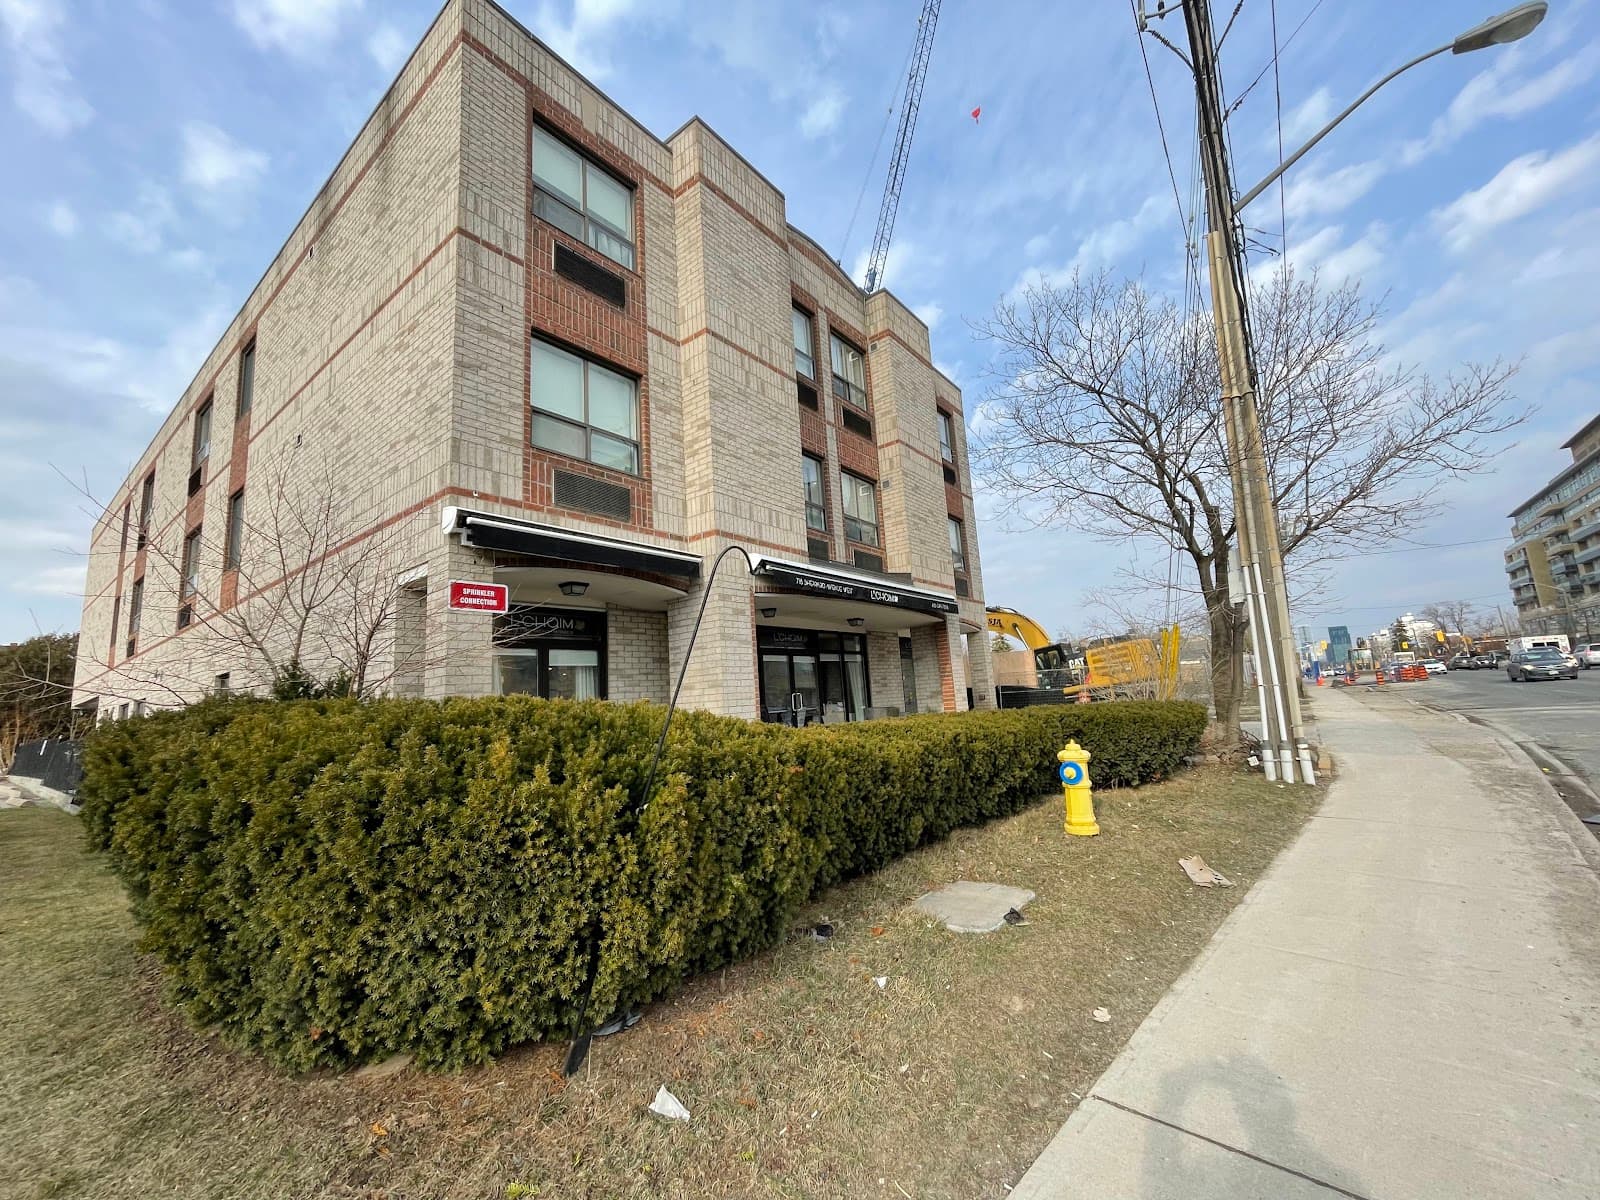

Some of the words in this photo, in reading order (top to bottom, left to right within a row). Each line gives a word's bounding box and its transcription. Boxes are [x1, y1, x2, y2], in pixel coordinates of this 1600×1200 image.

[462, 588, 495, 597] SPRINKLER
[460, 597, 498, 606] CONNECTION
[1068, 657, 1085, 670] CAT
